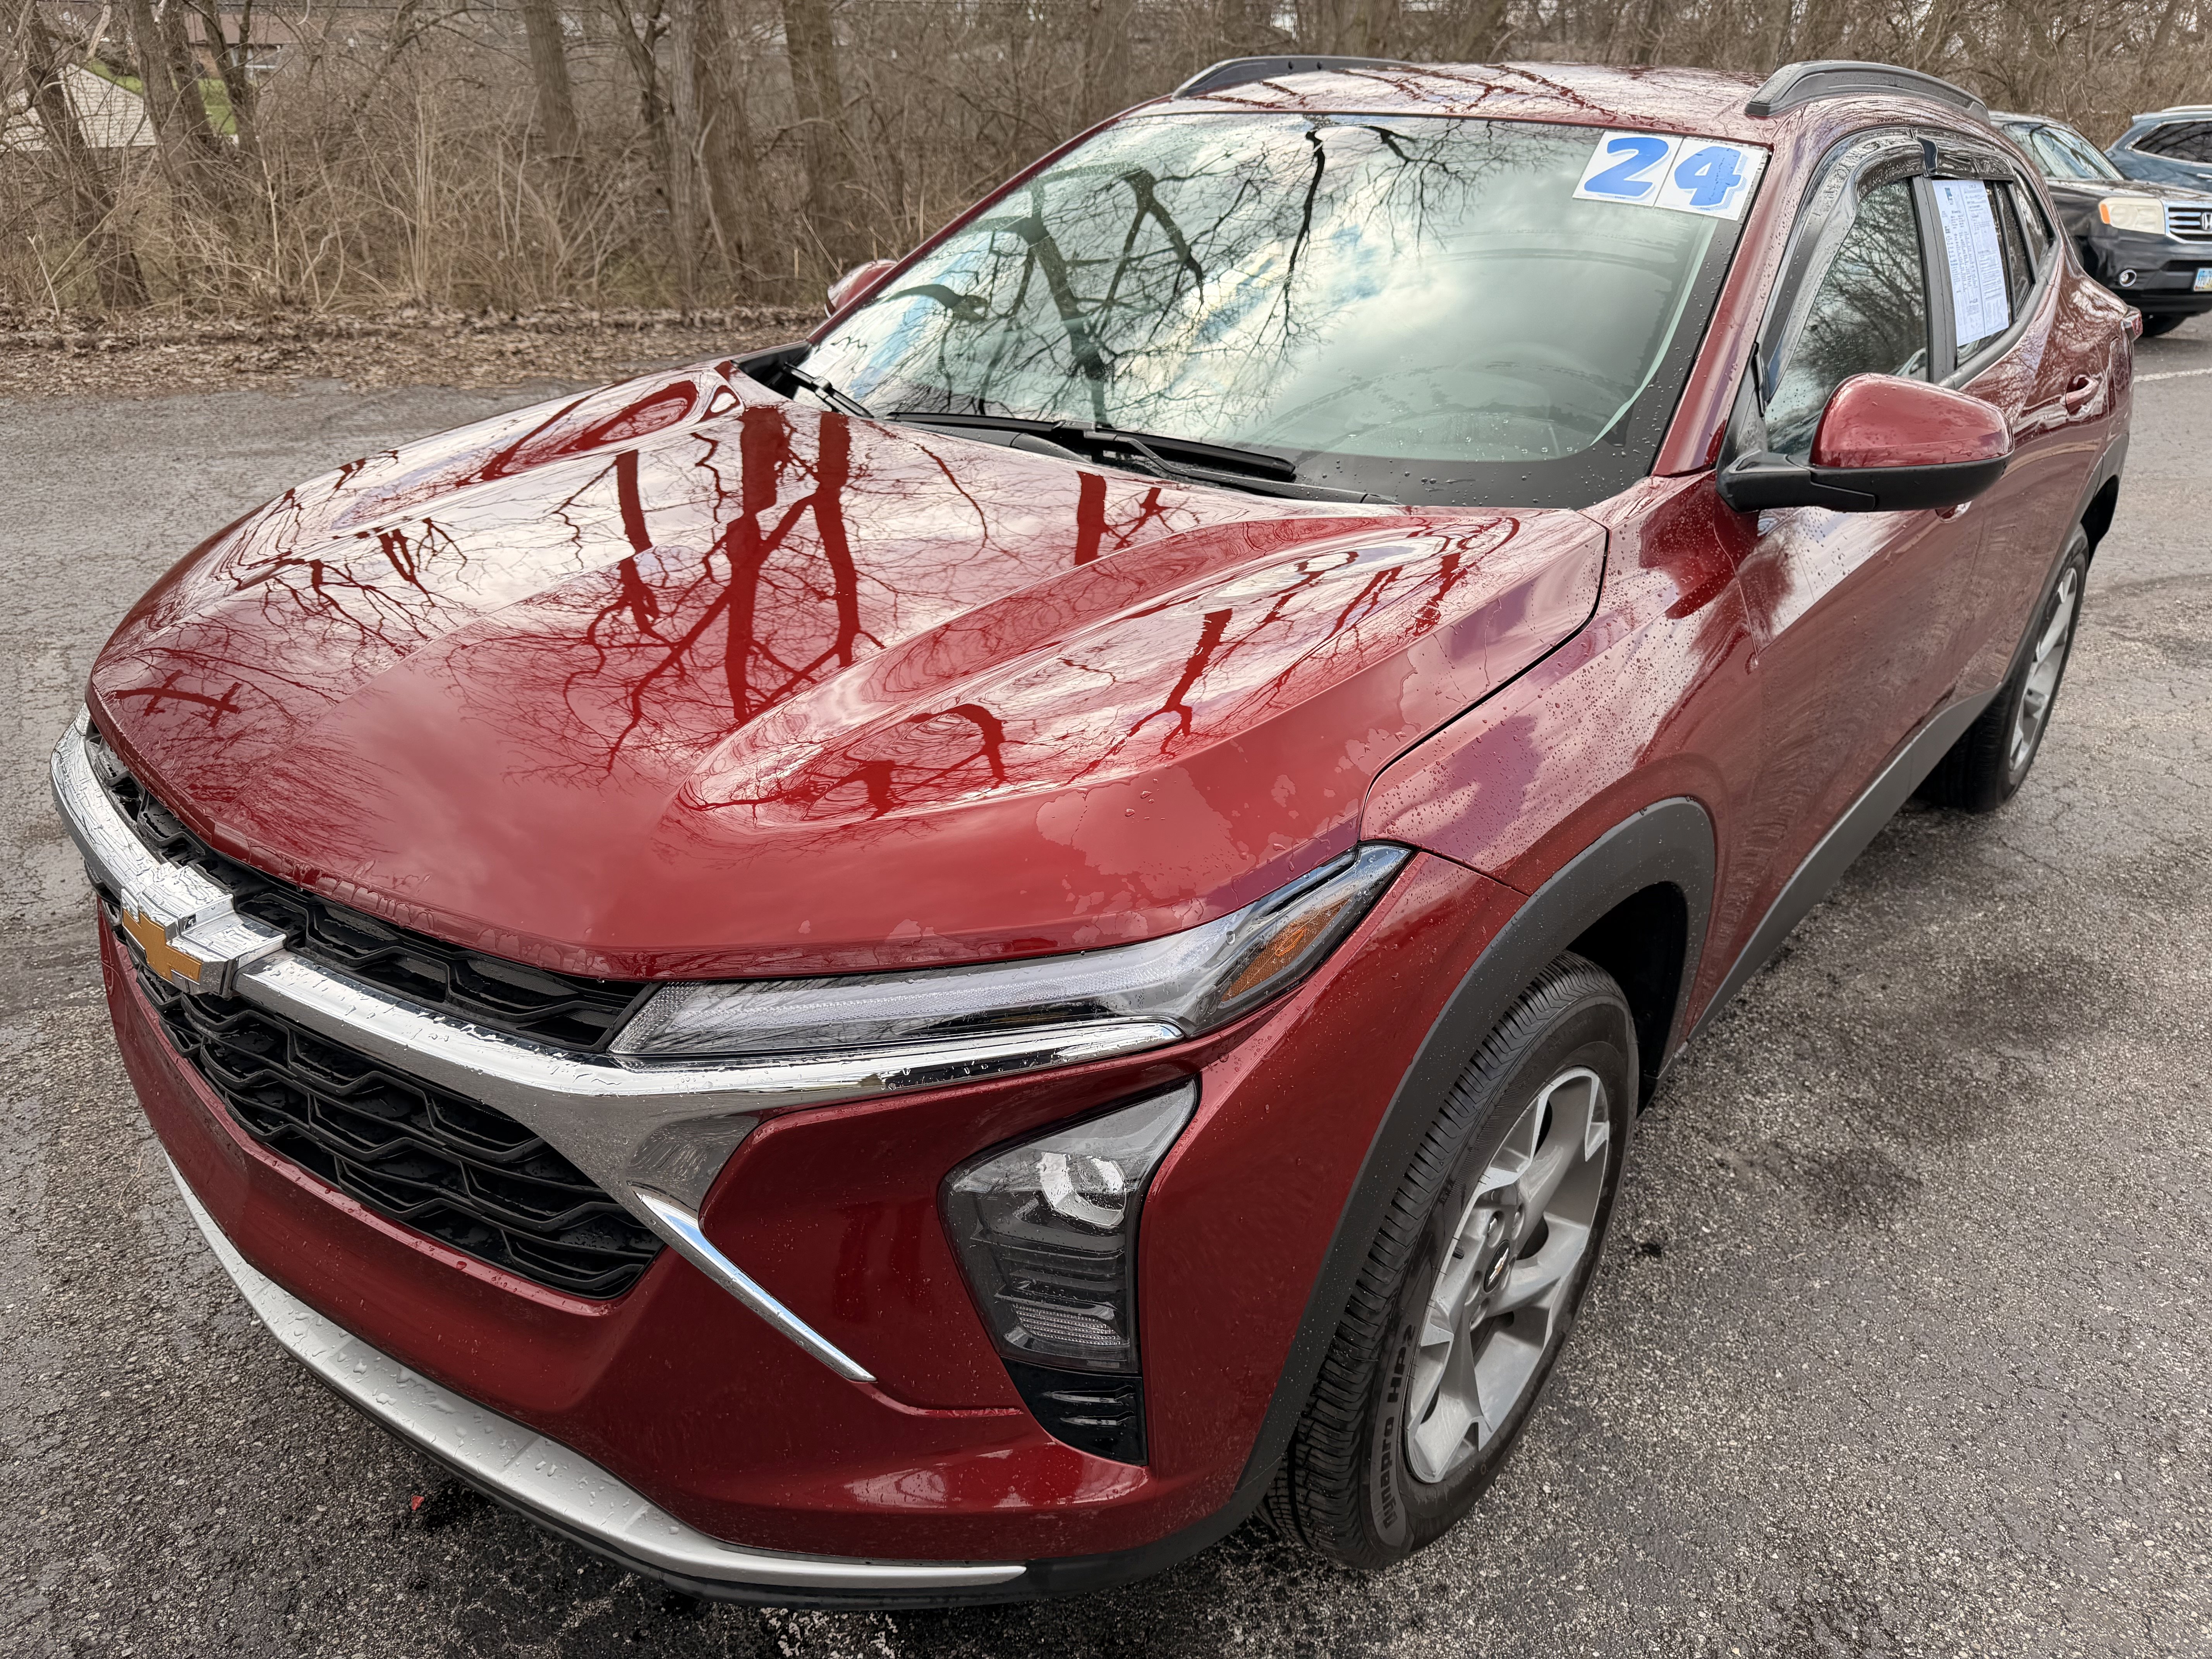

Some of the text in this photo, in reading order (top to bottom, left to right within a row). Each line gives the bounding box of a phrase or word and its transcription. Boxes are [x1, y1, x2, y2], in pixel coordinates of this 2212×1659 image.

[1584, 137, 1742, 206] 24
[1380, 1324, 1416, 1529] Dynapro HP2
